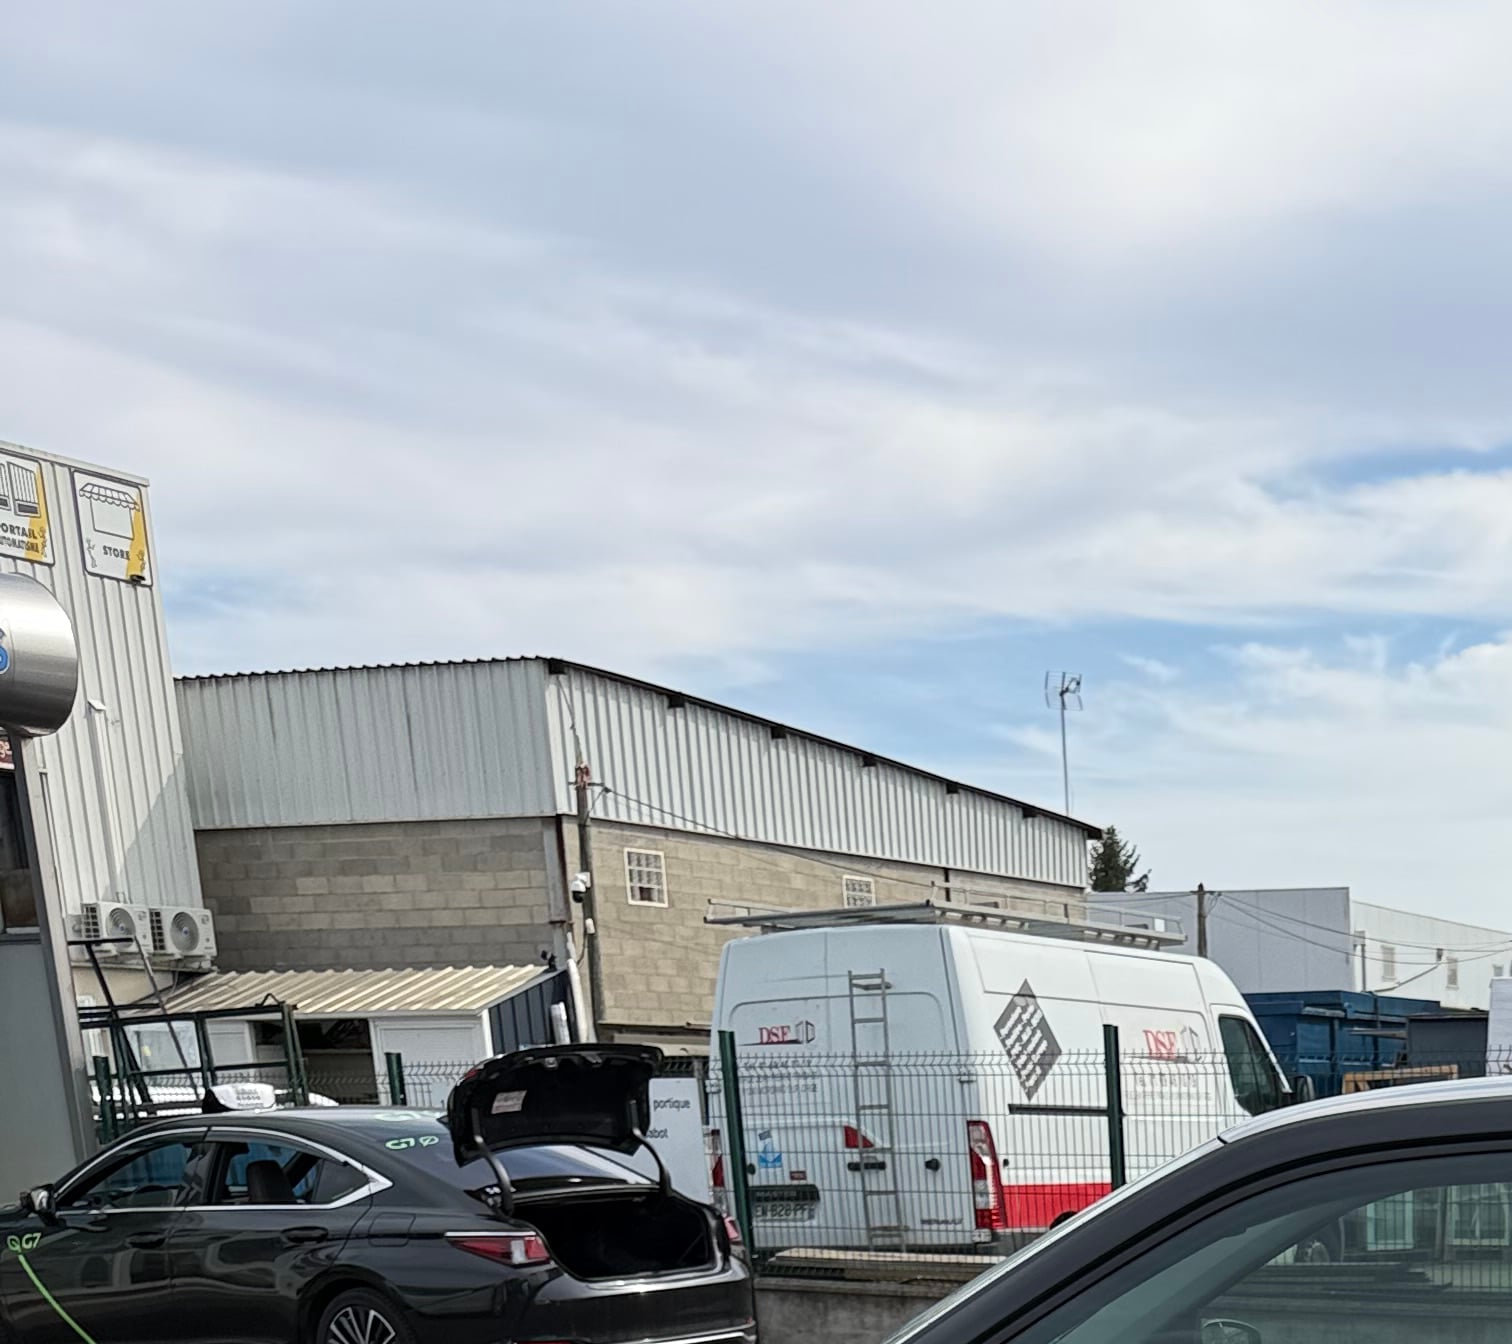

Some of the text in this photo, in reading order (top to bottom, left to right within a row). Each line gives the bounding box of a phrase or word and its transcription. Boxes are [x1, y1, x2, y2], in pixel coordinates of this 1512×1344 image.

[0, 522, 38, 540] ORTAIL
[103, 545, 130, 560] STORE
[653, 1097, 691, 1112] portique
[645, 1127, 669, 1139] abot
